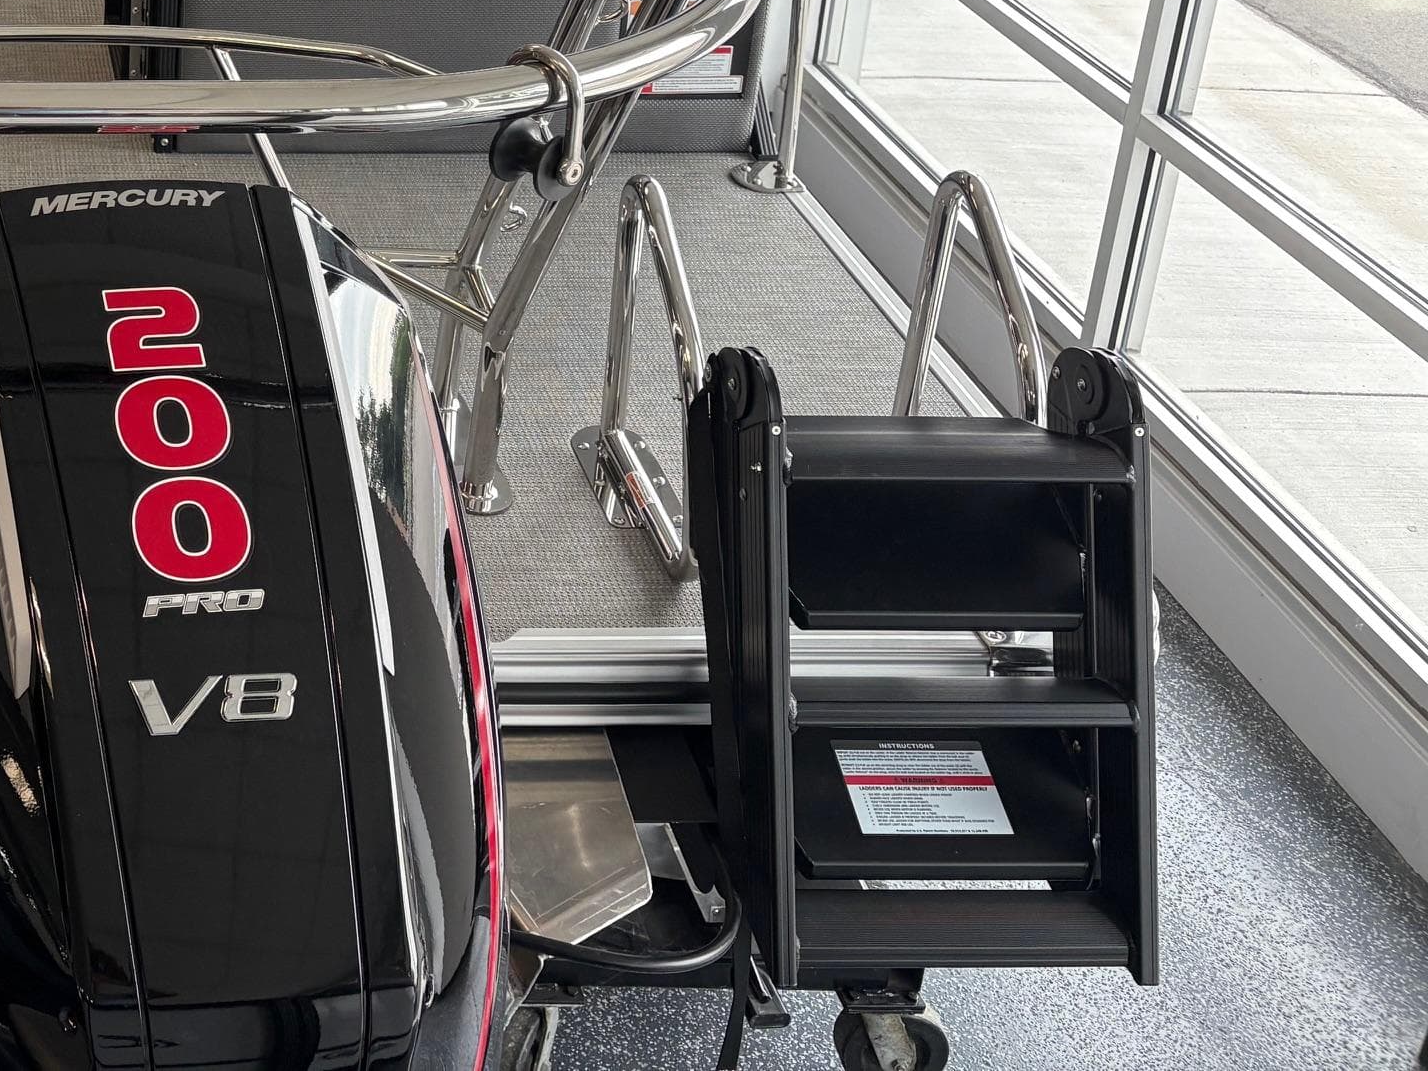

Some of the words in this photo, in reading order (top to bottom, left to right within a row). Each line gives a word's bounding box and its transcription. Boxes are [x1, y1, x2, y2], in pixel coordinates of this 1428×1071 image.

[30, 189, 225, 217] MERCURY
[102, 286, 252, 582] 200
[143, 588, 265, 617] PRO
[128, 672, 298, 736] V8
